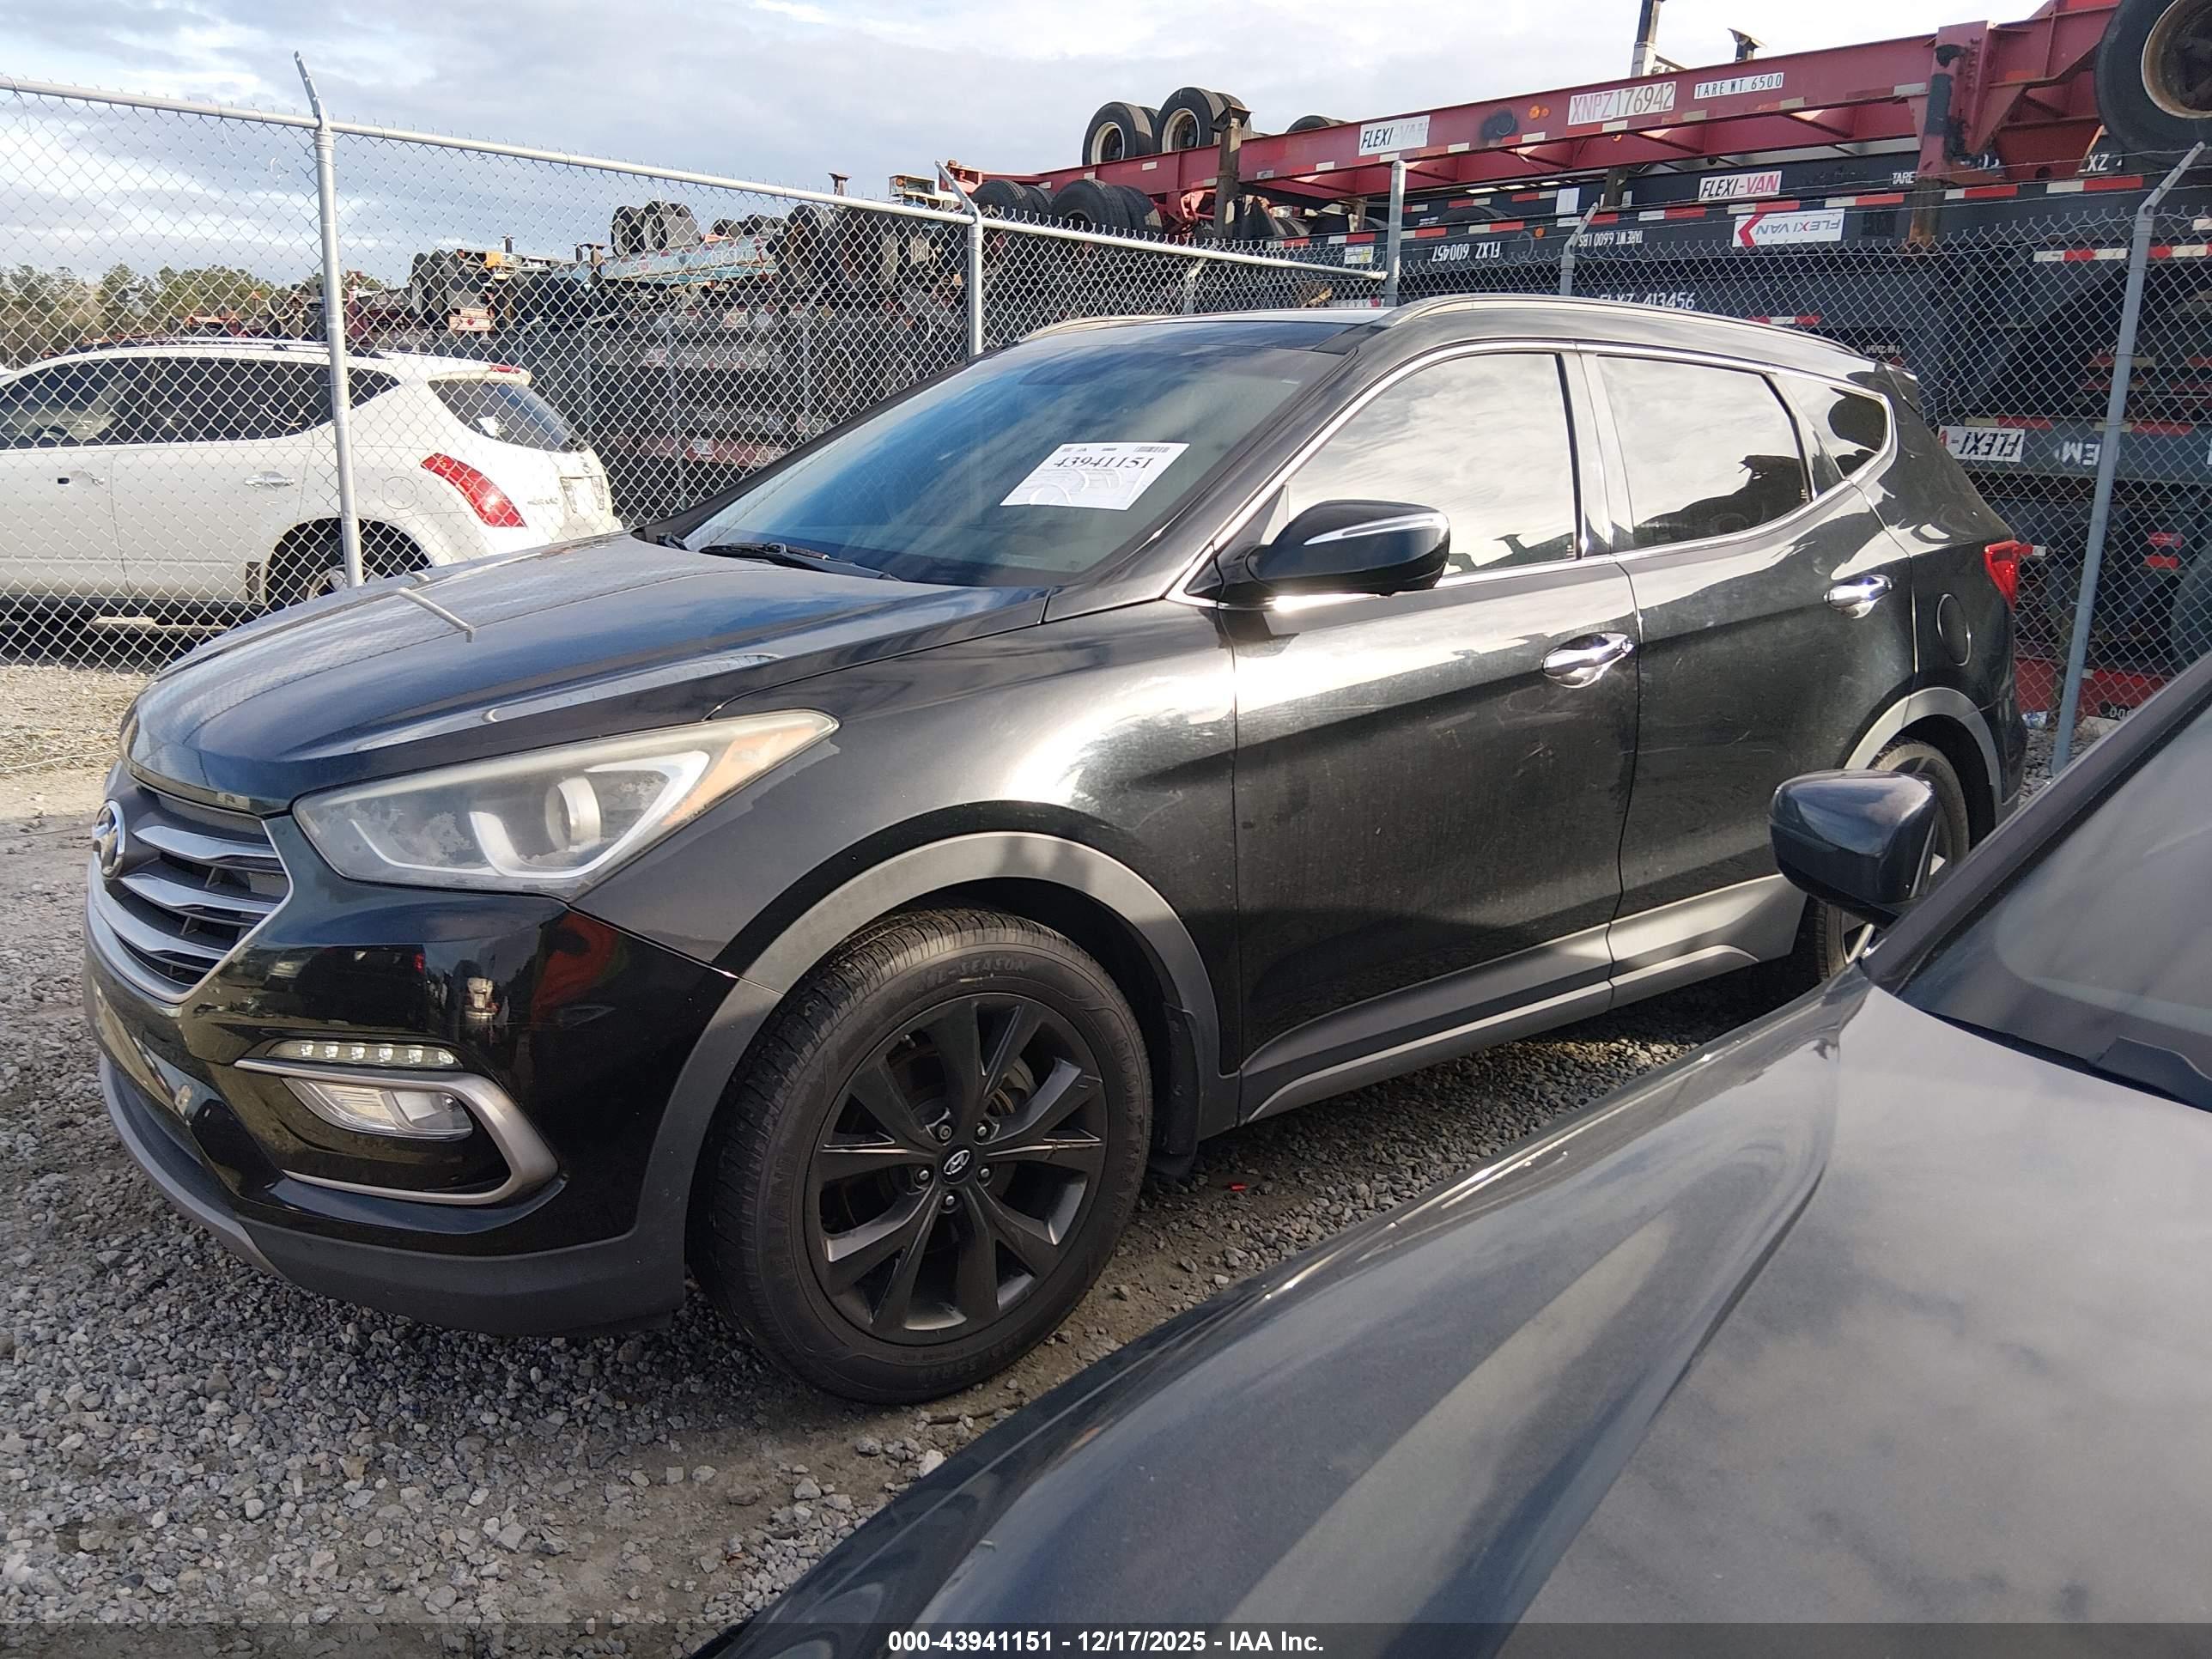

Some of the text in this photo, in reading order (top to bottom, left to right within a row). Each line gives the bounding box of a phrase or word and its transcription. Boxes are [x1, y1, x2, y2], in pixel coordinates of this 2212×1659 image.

[1697, 85, 1725, 98] TARE
[1751, 73, 1783, 90] 6500
[1700, 173, 1780, 199] FLEXI-VAN
[1755, 218, 1842, 235] FLEXI VAN
[1431, 241, 1501, 262] FLXZ 600457
[1054, 455, 1154, 469] 43941151
